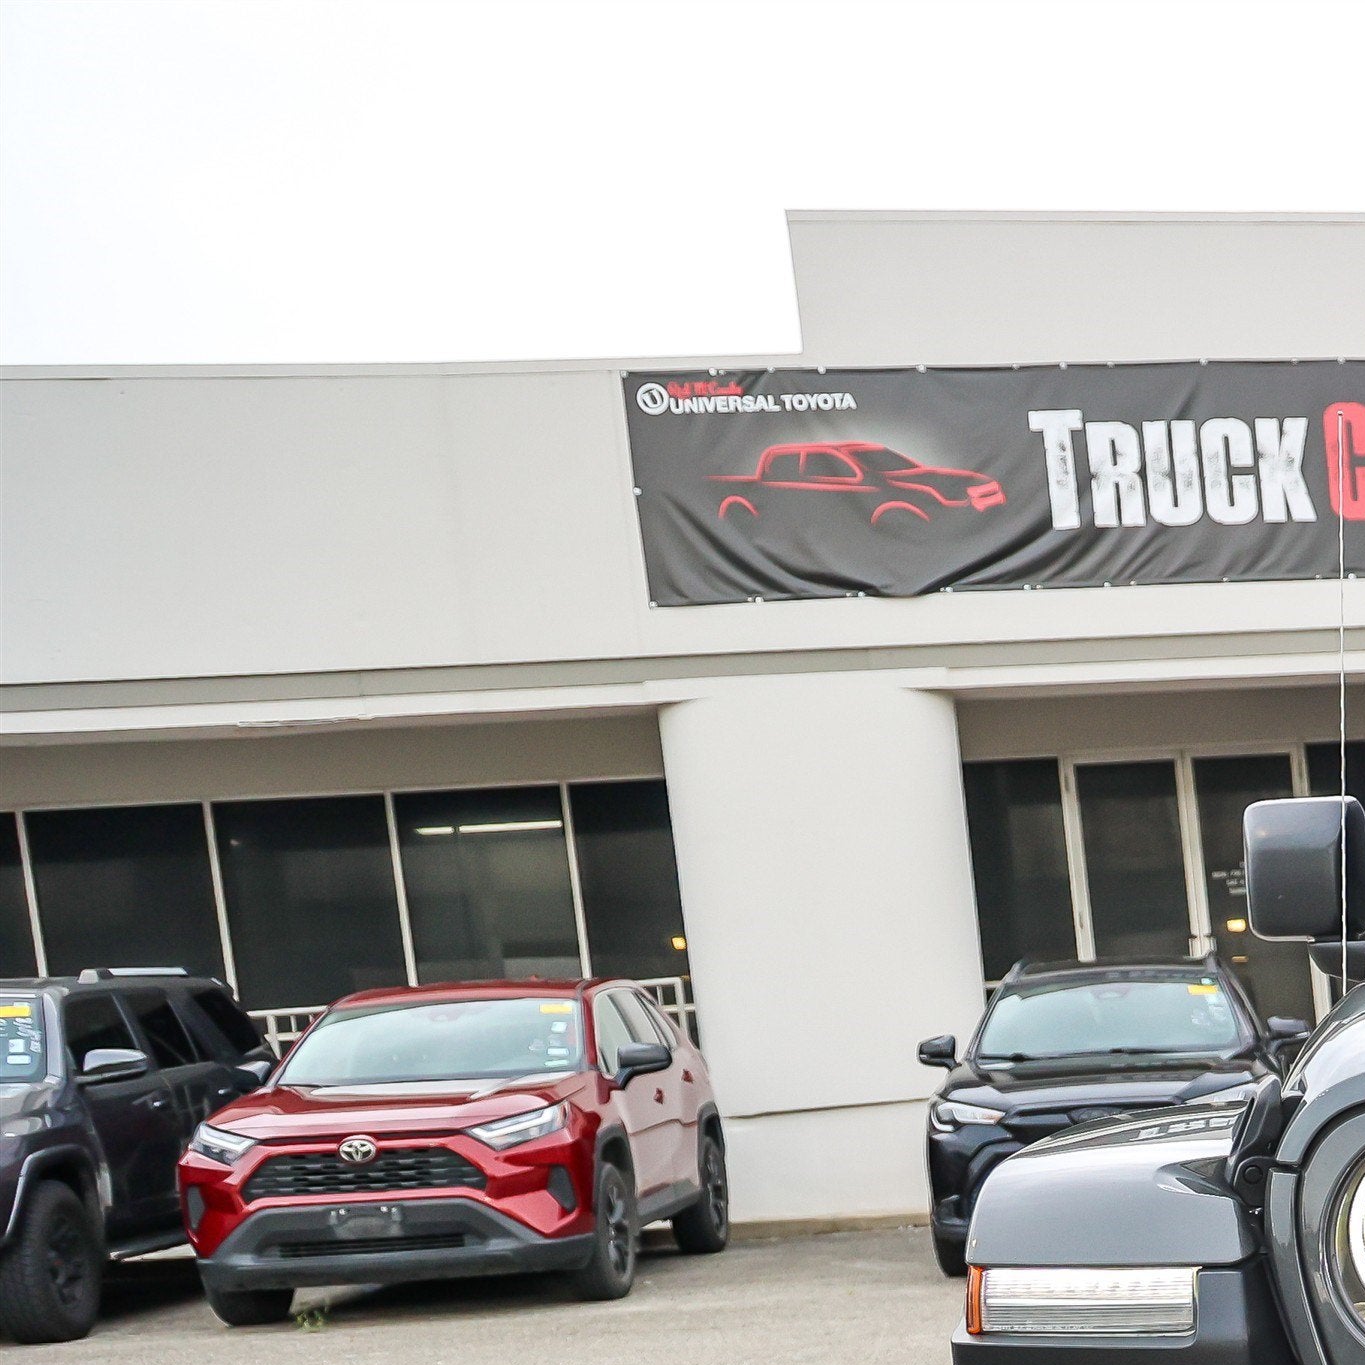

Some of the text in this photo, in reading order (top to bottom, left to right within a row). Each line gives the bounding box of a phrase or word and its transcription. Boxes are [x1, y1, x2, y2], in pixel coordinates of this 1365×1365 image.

[669, 392, 857, 415] UNIVERSAL TOYOTA
[1027, 409, 1317, 530] TRUCK
